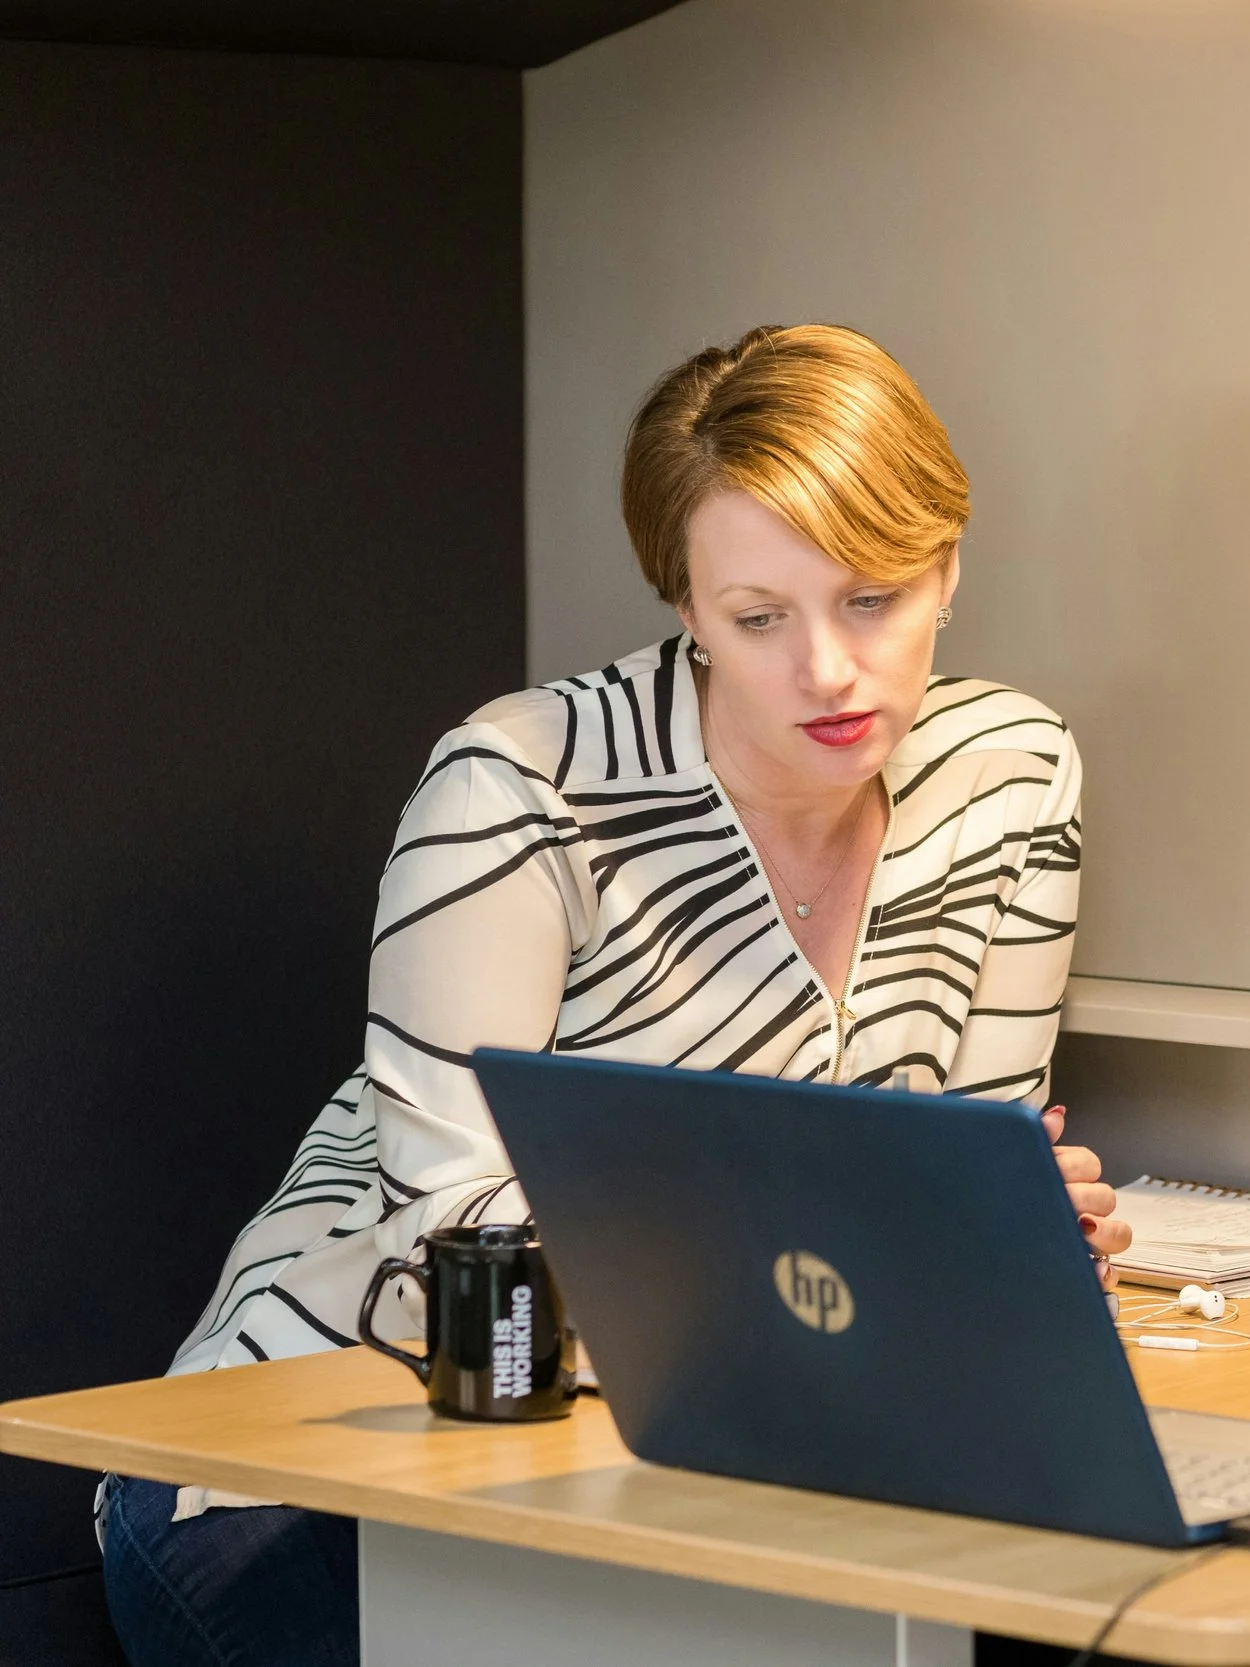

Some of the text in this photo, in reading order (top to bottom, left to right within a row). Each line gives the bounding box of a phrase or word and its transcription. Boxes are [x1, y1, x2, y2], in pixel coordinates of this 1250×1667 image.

[493, 1318, 513, 1399] THIS IS
[511, 1284, 533, 1399] WORKING
